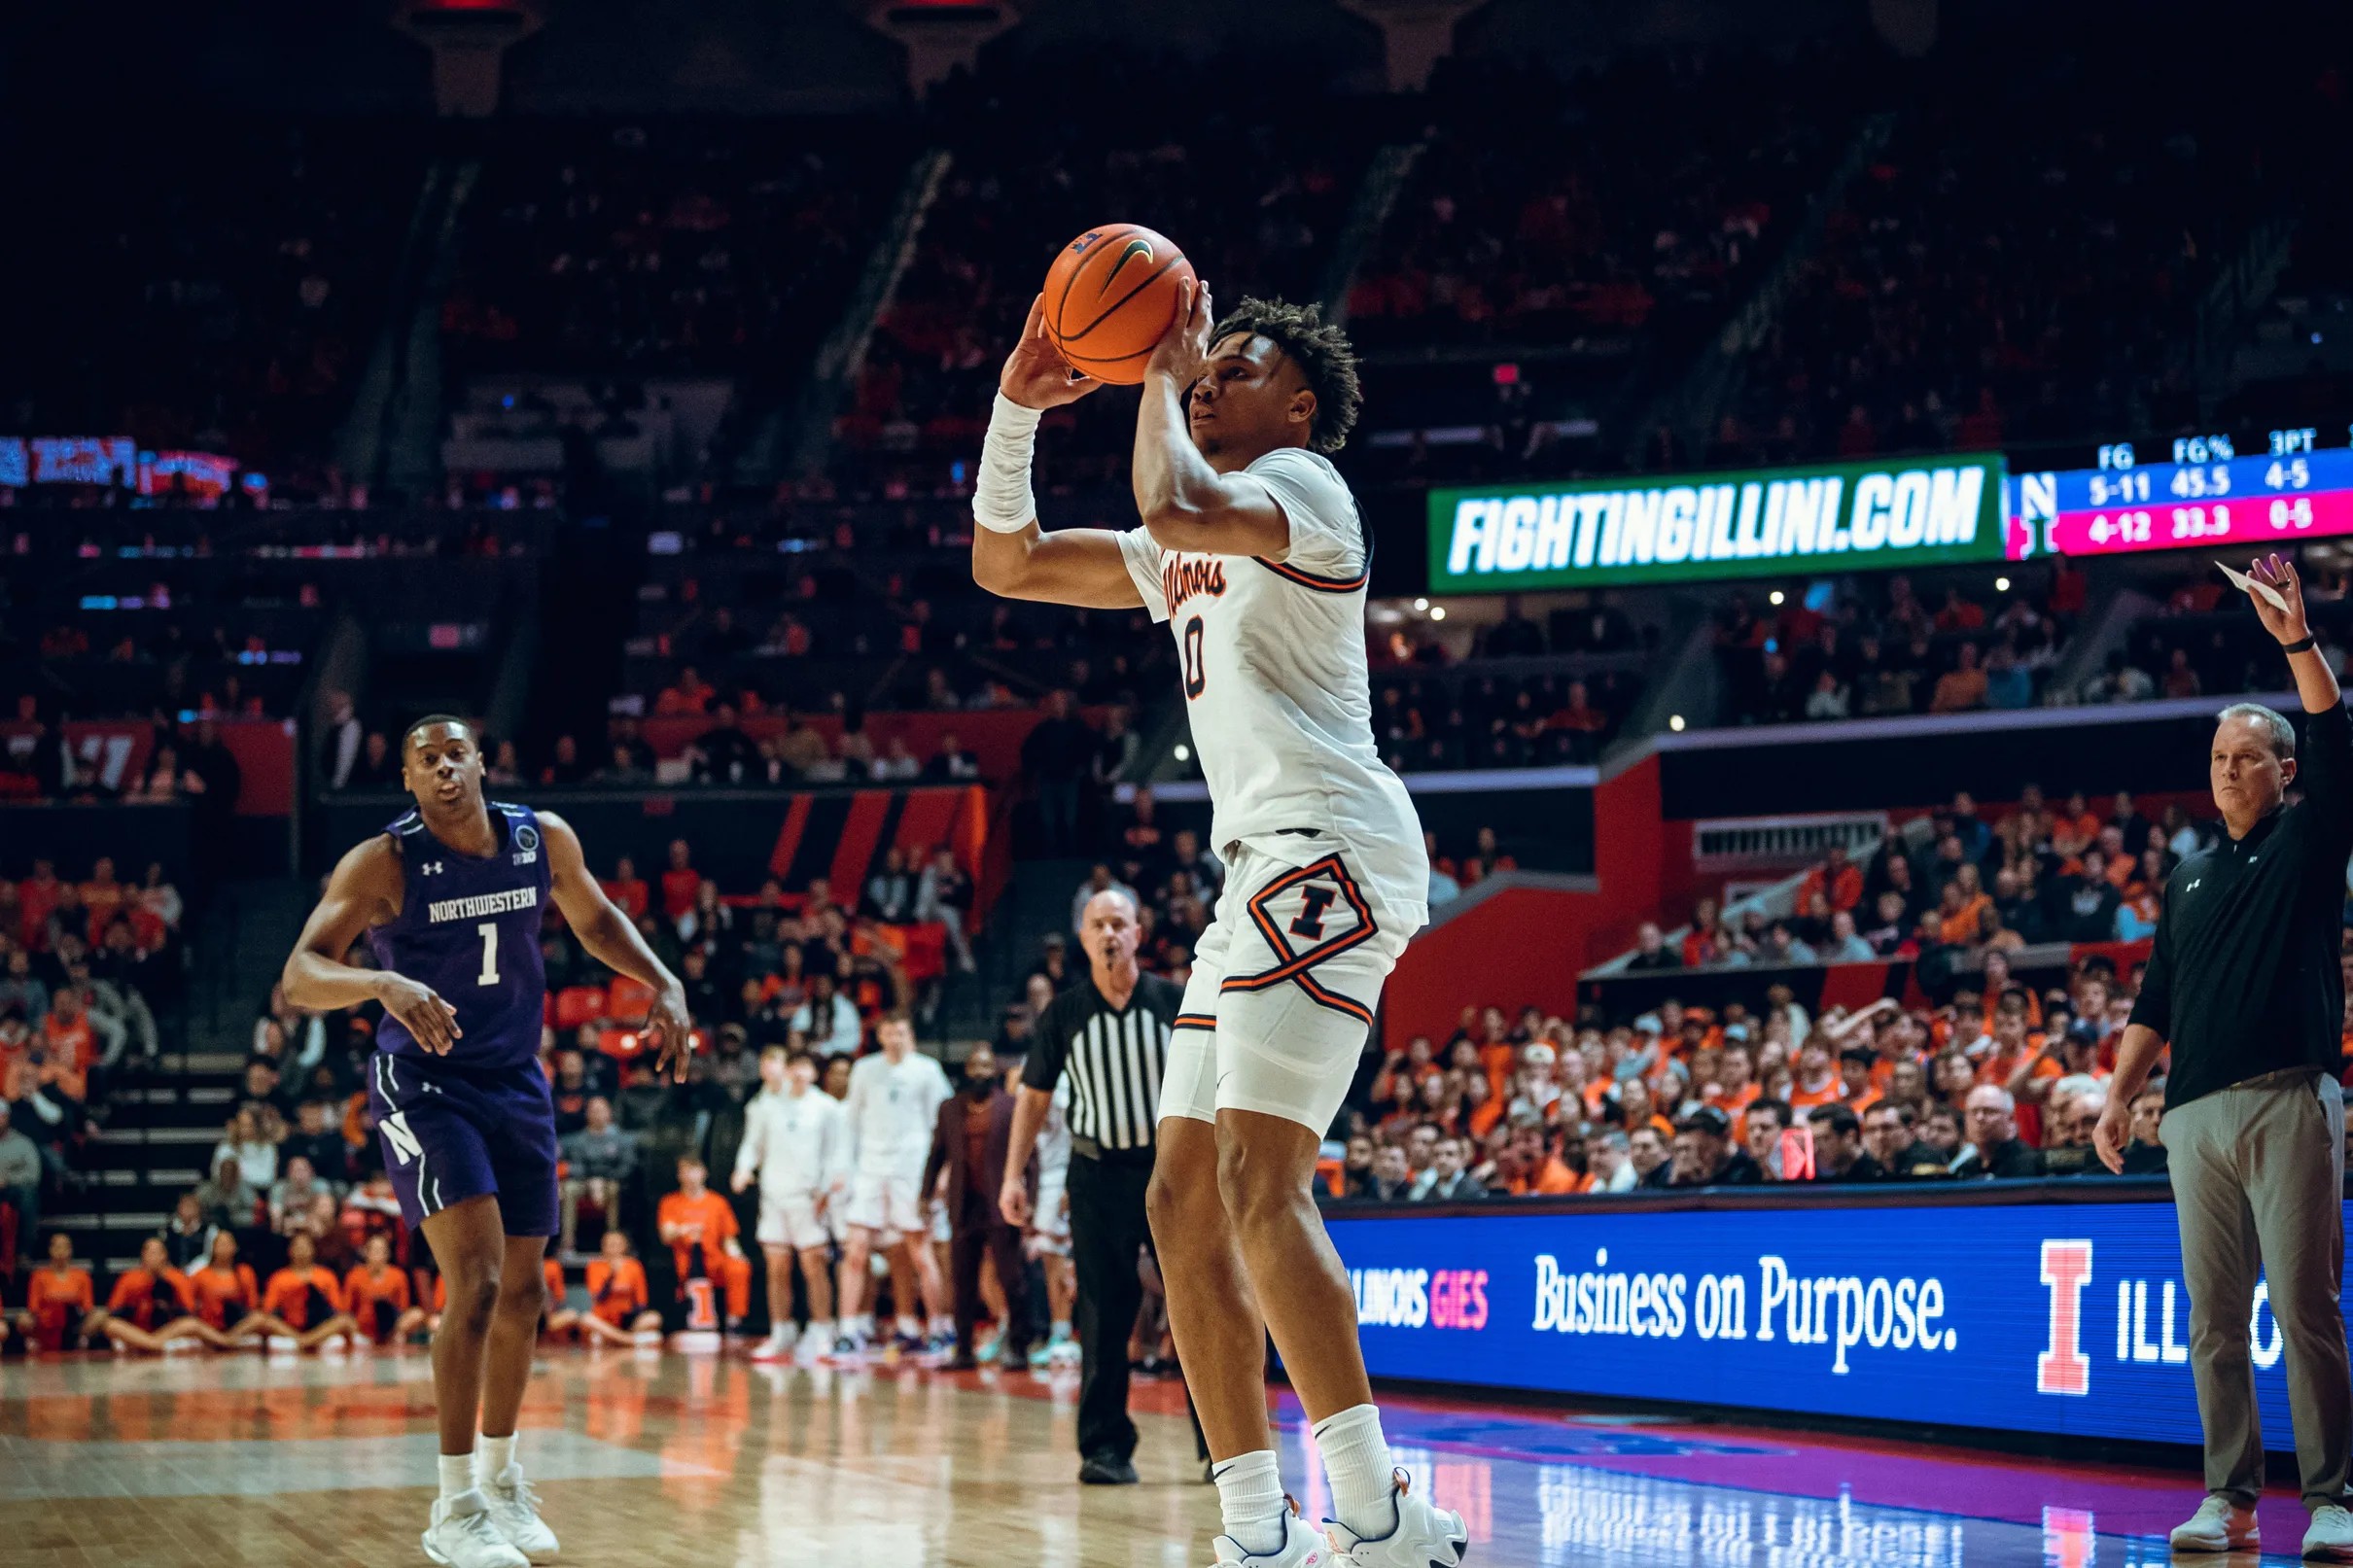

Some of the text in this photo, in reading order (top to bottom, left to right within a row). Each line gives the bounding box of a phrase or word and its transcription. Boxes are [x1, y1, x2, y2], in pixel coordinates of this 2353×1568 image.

[2098, 442, 2134, 470] FG
[2173, 434, 2234, 464] FG%
[2268, 428, 2316, 457] 3PT
[2020, 458, 2310, 519] N 5-11 45.5 4-5
[1449, 467, 1984, 574] FIGHTINGILLINI.COM
[2089, 511, 2152, 544] 4-12
[2268, 498, 2313, 530] 0-5
[1184, 614, 1206, 701] 0
[429, 887, 537, 923] NORTHWESTERN
[1289, 885, 1337, 941] I
[477, 923, 500, 986] 1
[379, 1110, 423, 1166] N
[1429, 1269, 1490, 1331] GIES
[1532, 1247, 1957, 1375] Business on Purpose.
[2037, 1238, 2092, 1396] I
